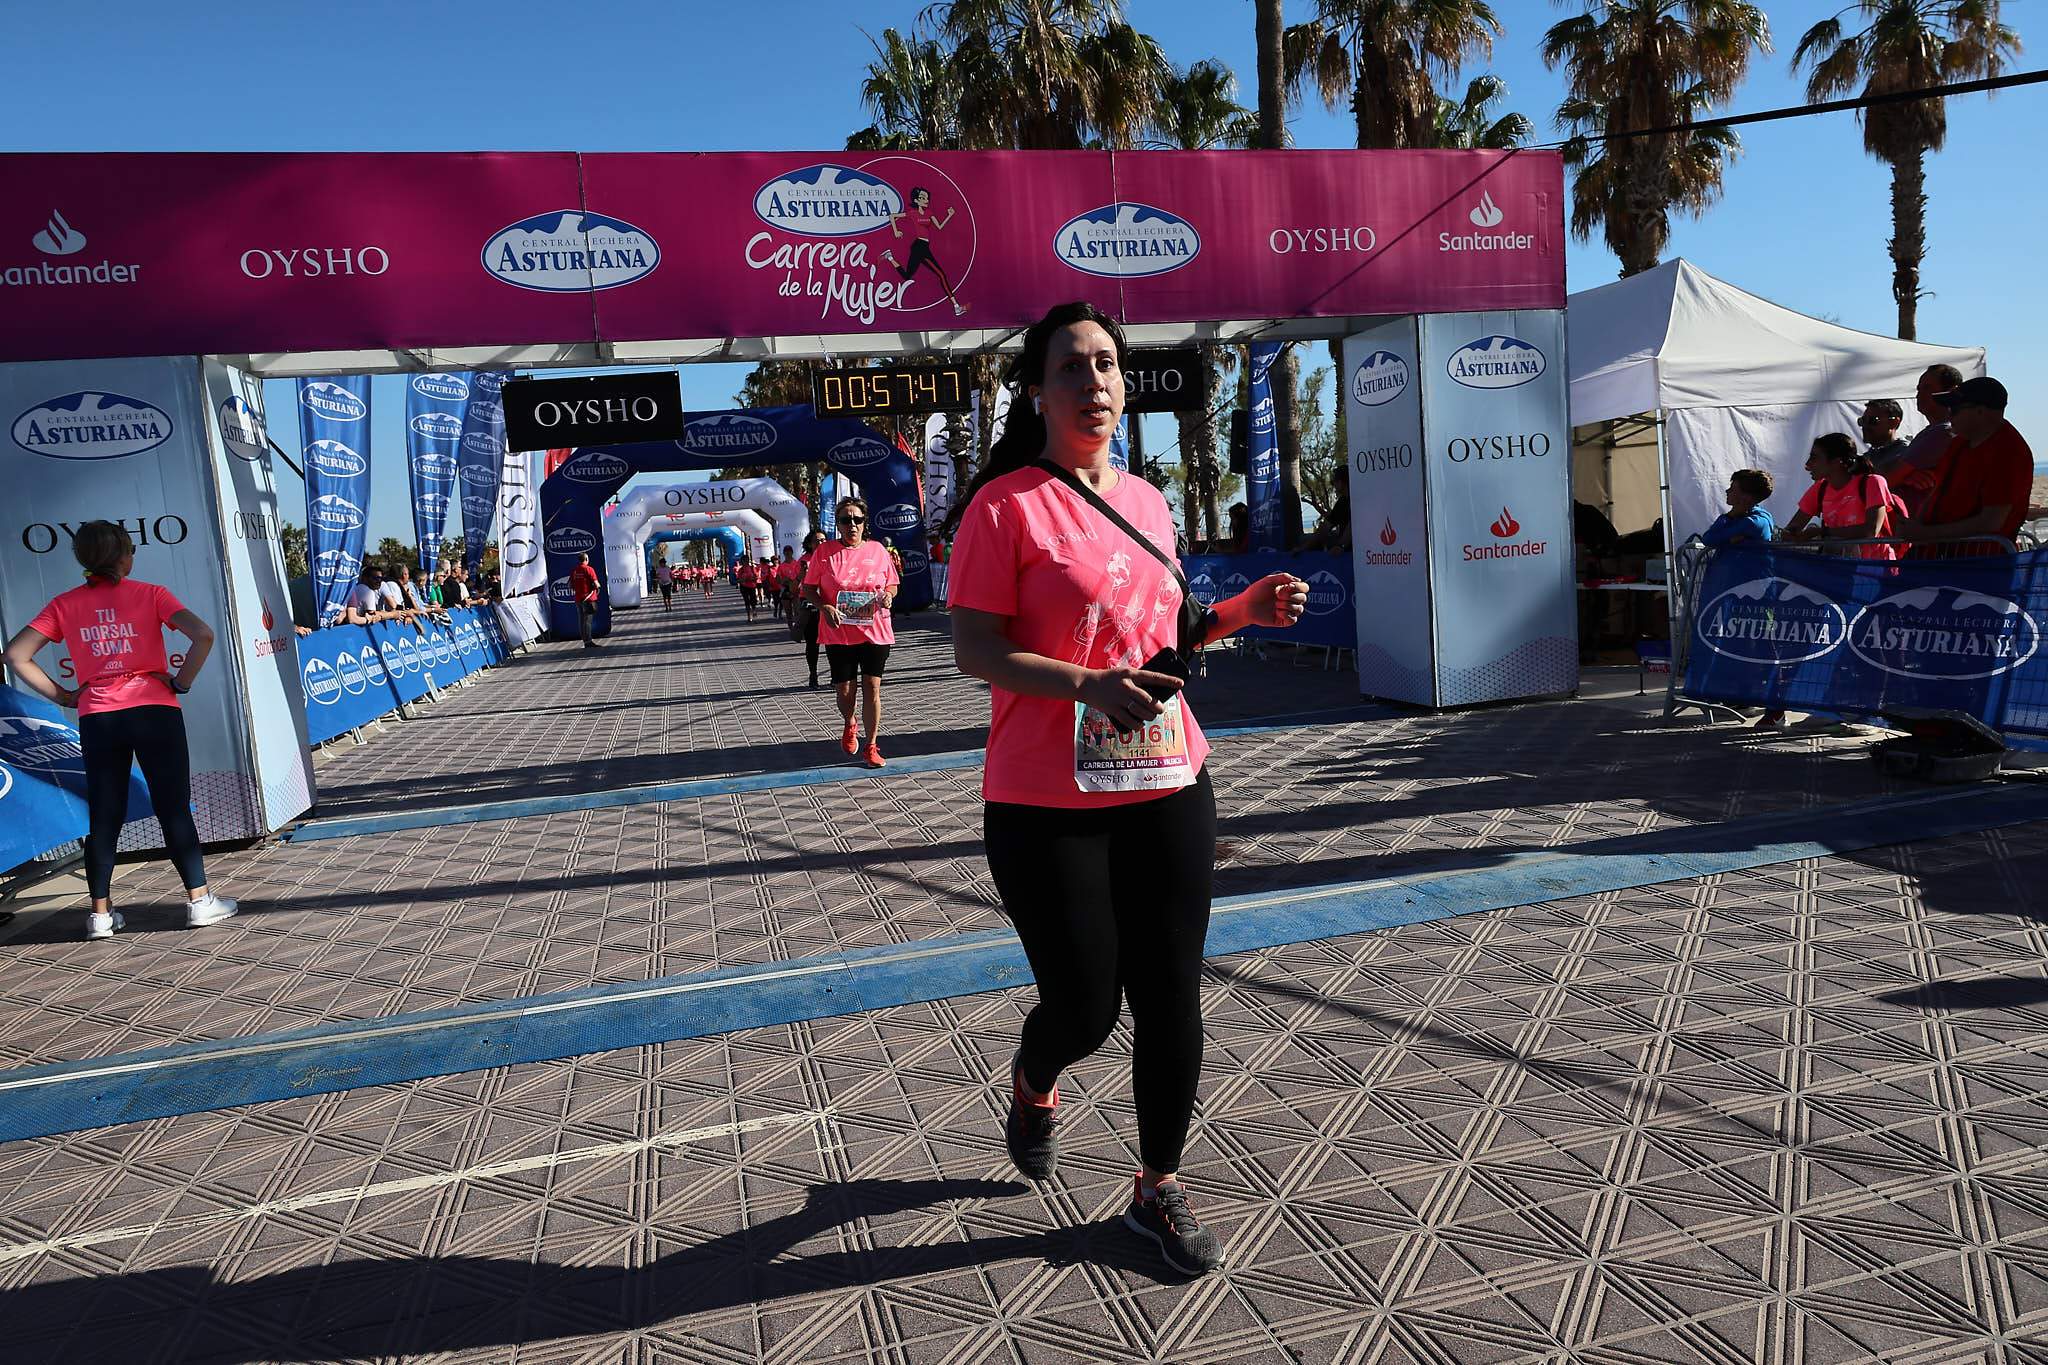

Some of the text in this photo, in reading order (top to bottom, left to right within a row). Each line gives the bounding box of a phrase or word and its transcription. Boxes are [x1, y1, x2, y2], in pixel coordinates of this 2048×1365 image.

[767, 191, 892, 218] ASTURIANA
[522, 238, 580, 247] CENTRAL
[1087, 227, 1184, 236] CENTRAL LECHERA
[1269, 226, 1376, 254] OYSHO
[1439, 231, 1534, 251] Santander
[745, 232, 869, 269] Carrera
[1066, 230, 1190, 258] ASTURIANA
[240, 246, 390, 278] OYSHO
[497, 242, 649, 272] ASTURIANA
[779, 264, 915, 325] de la Mujer
[1455, 357, 1539, 378] ASTURIANA
[825, 371, 960, 410] 00:57:47
[1124, 368, 1183, 394] SHO
[1356, 372, 1404, 397] ASTURIANA
[308, 390, 360, 416] ASTURIANA
[534, 396, 658, 427] OYSHO
[48, 413, 155, 424] CENTRAL LECHERA
[25, 419, 163, 446] ASTURIANA
[684, 430, 770, 448] ASTURIANA
[832, 445, 886, 462] ASTURIANA
[1357, 443, 1412, 474] OYSHO
[1448, 433, 1550, 463] OYSHO
[566, 459, 624, 477] ASTURIANA
[664, 485, 746, 507] OYSHO
[234, 510, 276, 541] OYSHO
[549, 539, 593, 549] ASTURIANA
[1463, 540, 1547, 561] Santander
[1366, 550, 1412, 565] Santander
[1308, 591, 1340, 604] STURIANA
[96, 608, 116, 624] TU
[1705, 606, 1831, 645] ASTURIANA
[80, 622, 139, 643] DORSAL
[1861, 613, 2019, 658] ASTURIANA
[91, 639, 133, 657] SUMA
[255, 637, 288, 659] Santander
[105, 660, 124, 670] 2024
[1129, 748, 1150, 757] 1141
[1083, 761, 1115, 769] CARRERA
[1116, 760, 1125, 768] DE
[1136, 759, 1158, 768] MUJER
[1089, 773, 1130, 784] OYSHO
